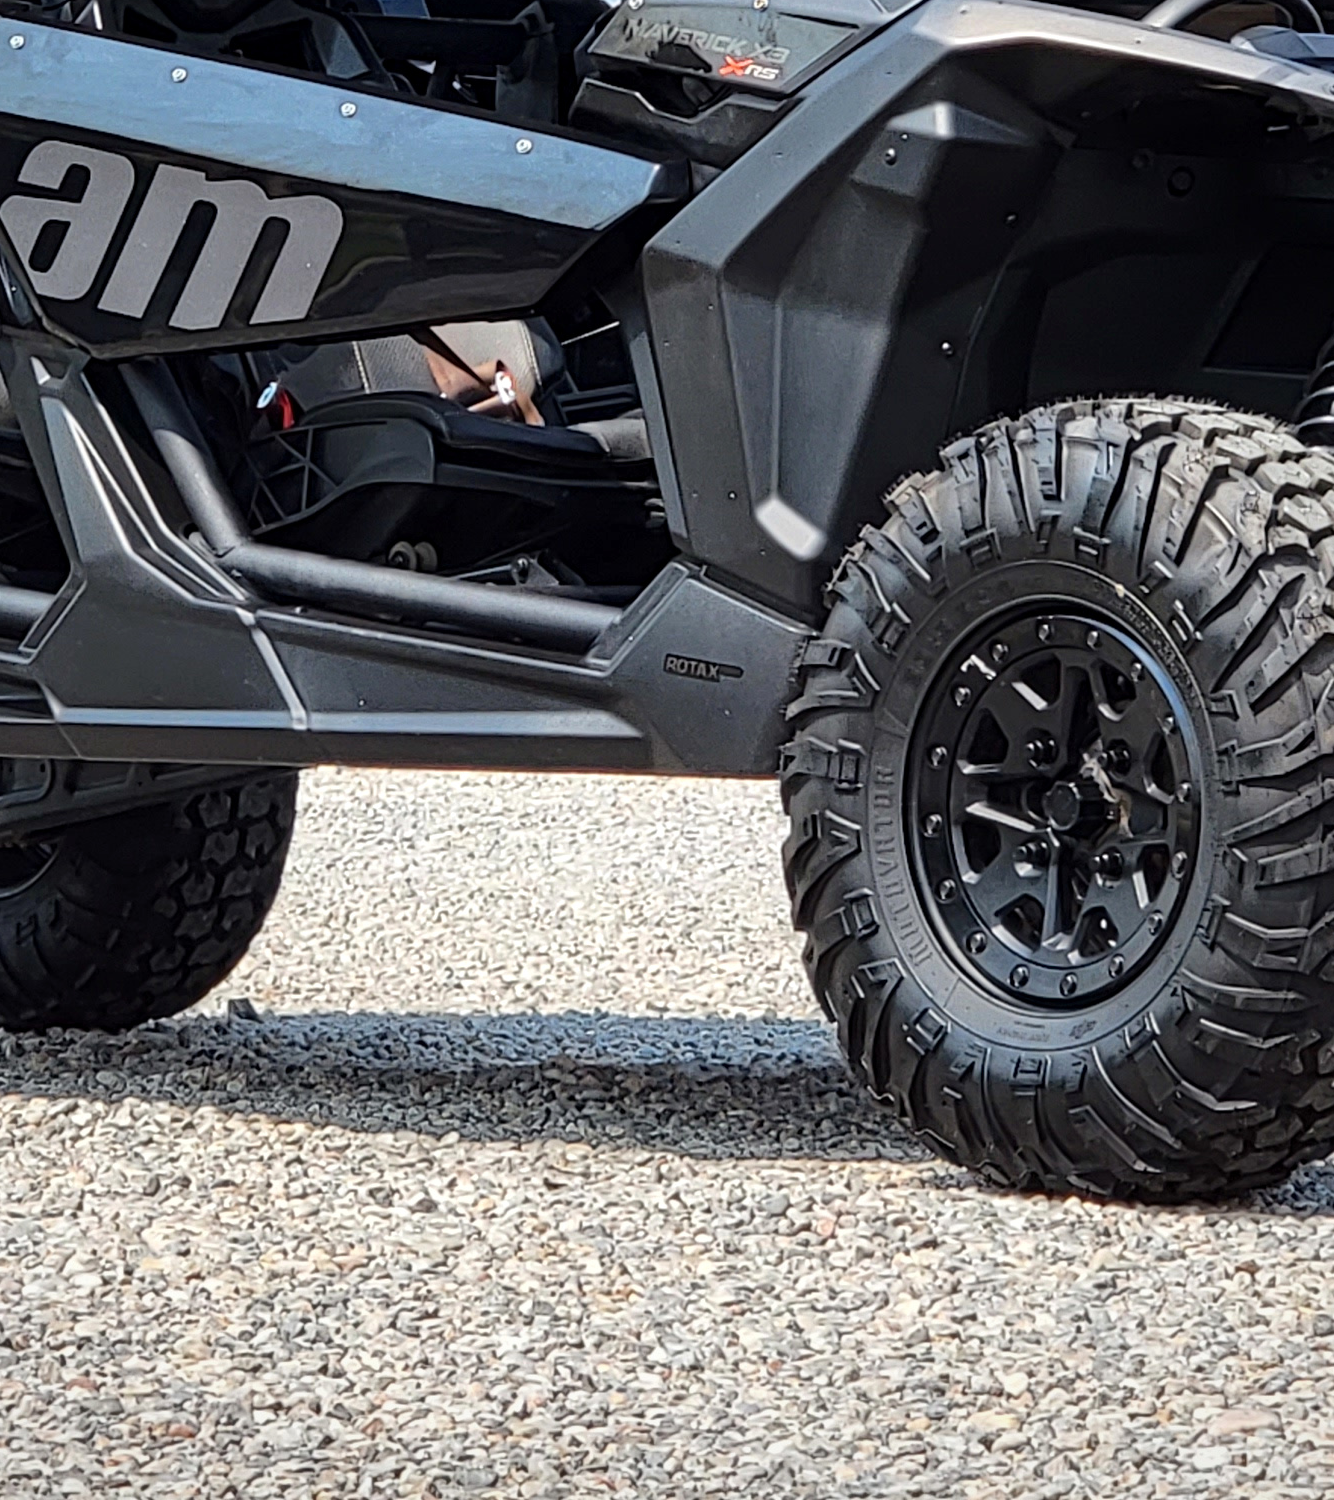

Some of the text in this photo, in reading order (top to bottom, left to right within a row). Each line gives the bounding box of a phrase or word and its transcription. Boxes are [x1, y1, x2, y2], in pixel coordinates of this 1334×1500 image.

[625, 17, 791, 65] MAVERICK X3
[0, 140, 344, 331] am
[665, 655, 720, 680] ROTAX
